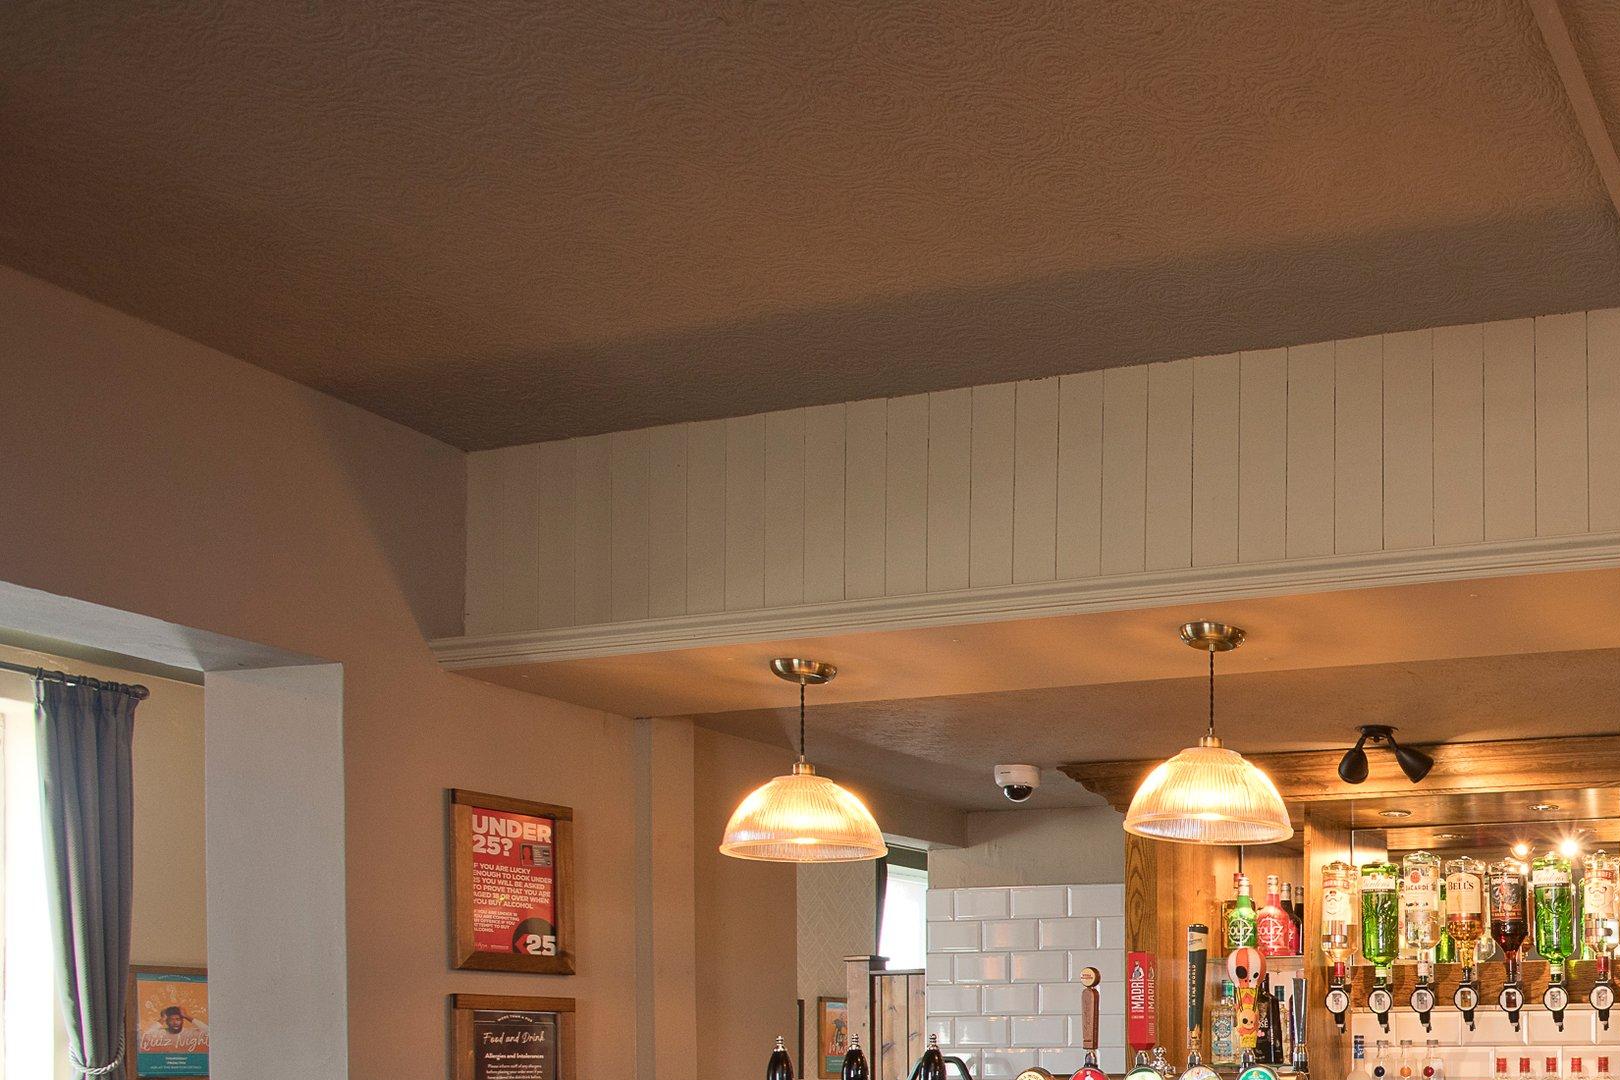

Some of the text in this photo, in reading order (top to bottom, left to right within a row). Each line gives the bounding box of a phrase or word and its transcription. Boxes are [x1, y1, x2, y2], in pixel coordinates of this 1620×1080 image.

[472, 814, 552, 843] UNDER
[472, 834, 513, 857] 25?
[524, 882, 545, 890] ASKED
[531, 876, 552, 884] UNDER
[1448, 880, 1474, 891] BELL'S
[526, 934, 557, 956] 25
[483, 1031, 545, 1044] Food and Drink
